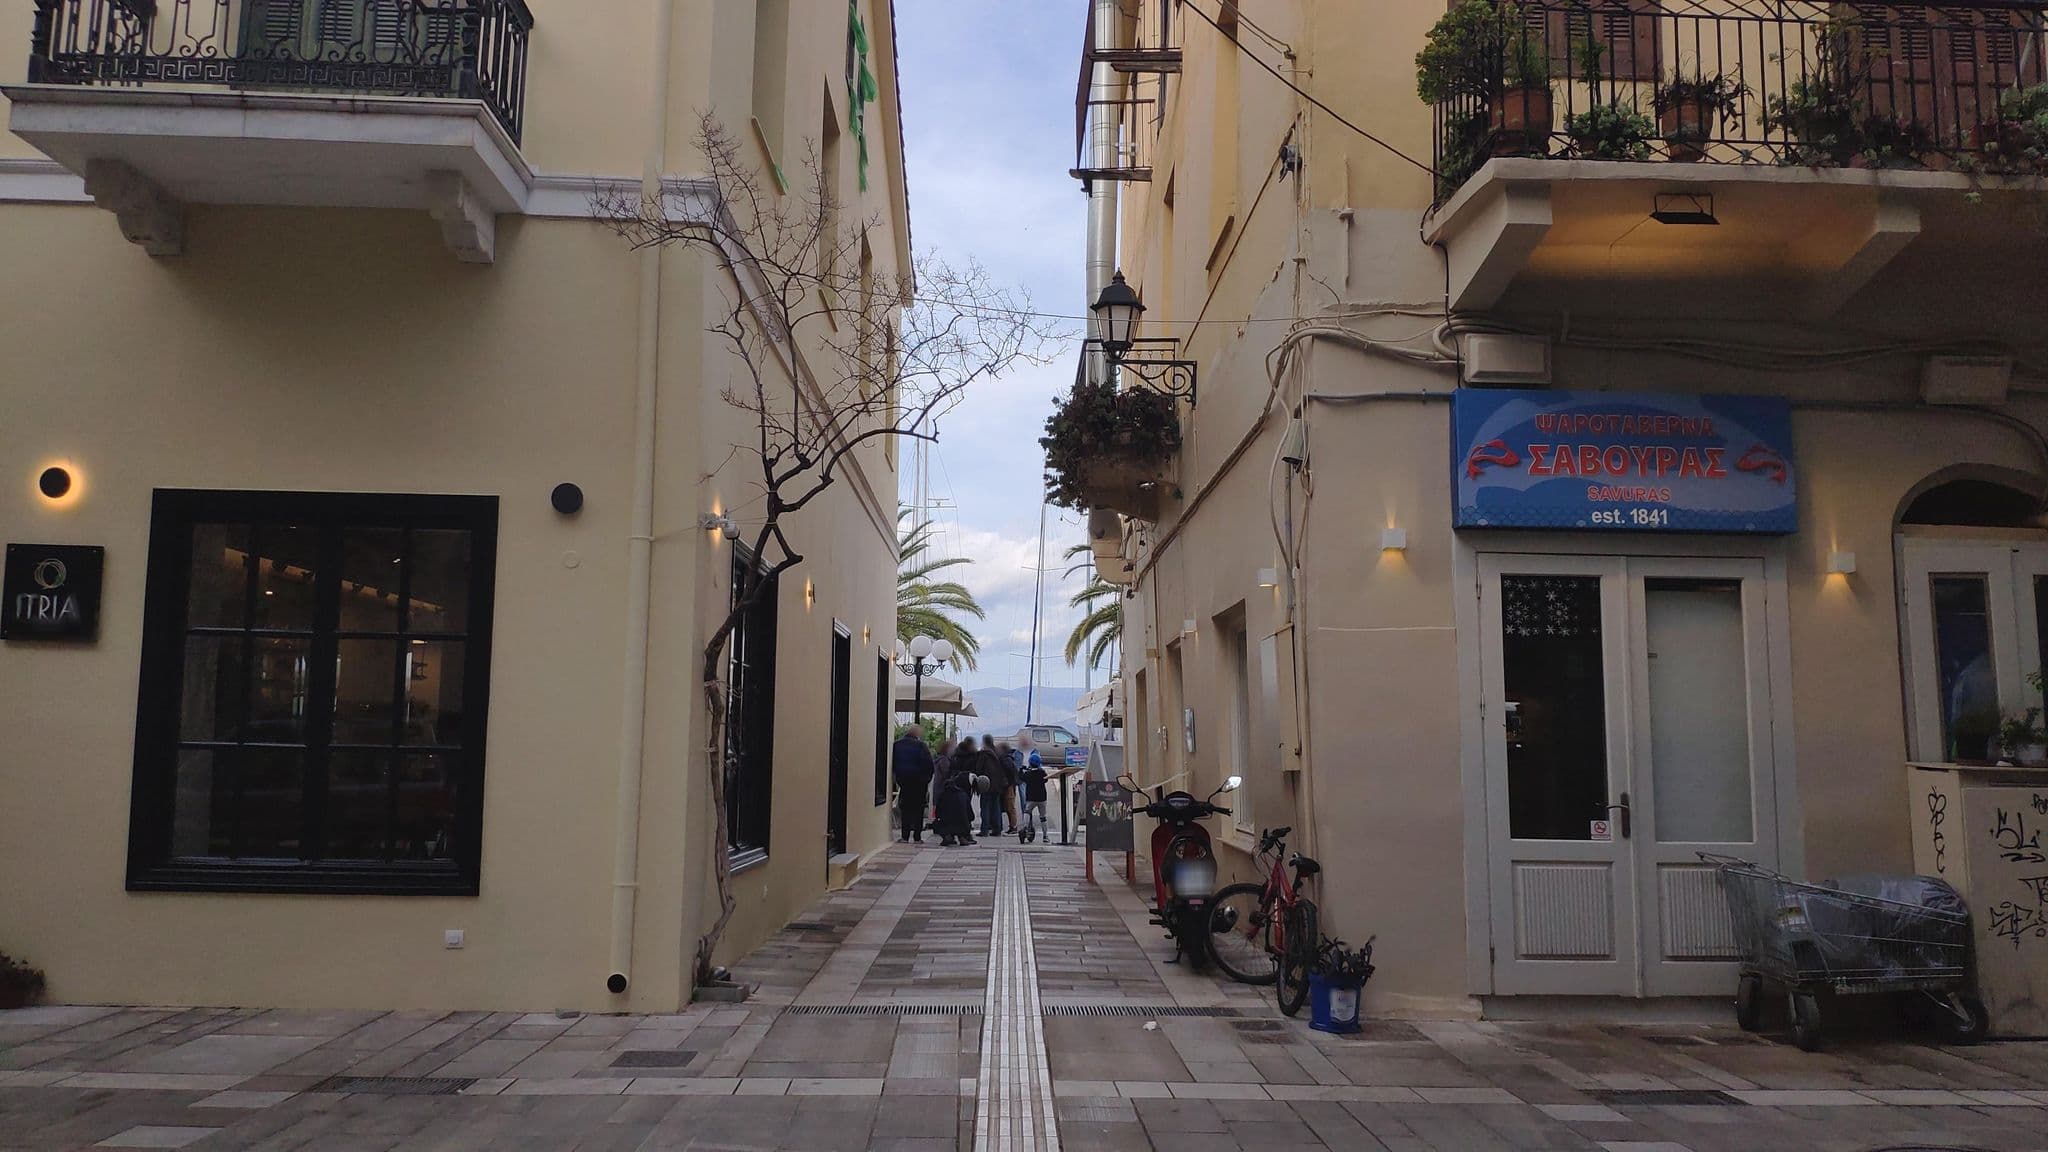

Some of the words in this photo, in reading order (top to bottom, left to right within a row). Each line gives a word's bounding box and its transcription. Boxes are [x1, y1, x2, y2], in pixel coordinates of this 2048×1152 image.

[1535, 413, 1713, 436] ΨΑΡΟΤΑΒΕΡΝΑ
[1528, 444, 1728, 479] ΣΑΒΟΥΡΑΣ
[1587, 485, 1671, 502] SAVURAS
[1591, 509, 1625, 524] est.
[1629, 508, 1668, 525] 1841
[16, 593, 79, 620] ITRIA
